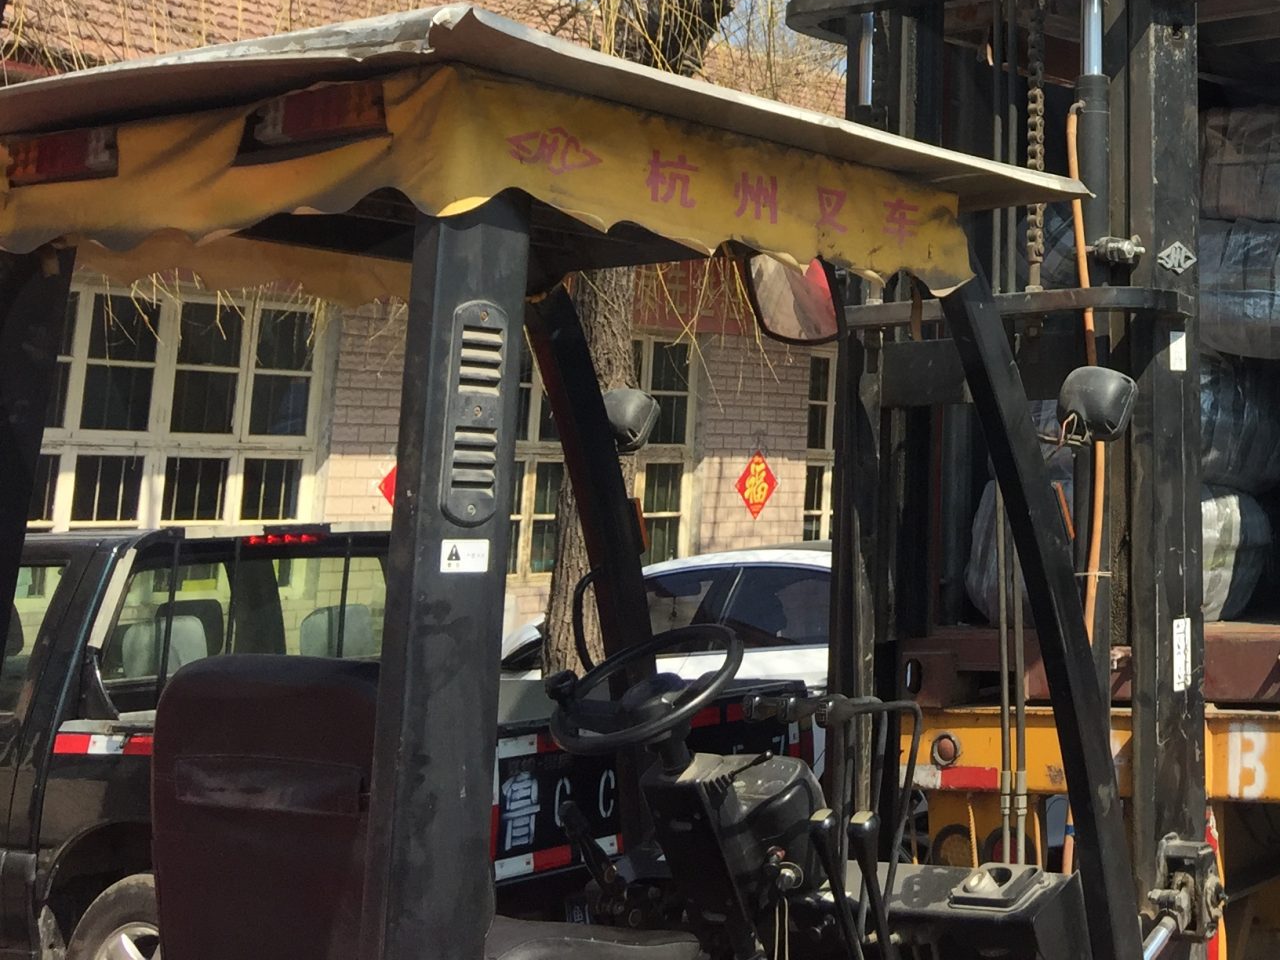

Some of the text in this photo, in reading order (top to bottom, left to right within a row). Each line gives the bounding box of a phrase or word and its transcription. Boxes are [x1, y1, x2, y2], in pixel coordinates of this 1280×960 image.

[645, 148, 920, 244] 杭州叉车
[743, 462, 769, 505] 福
